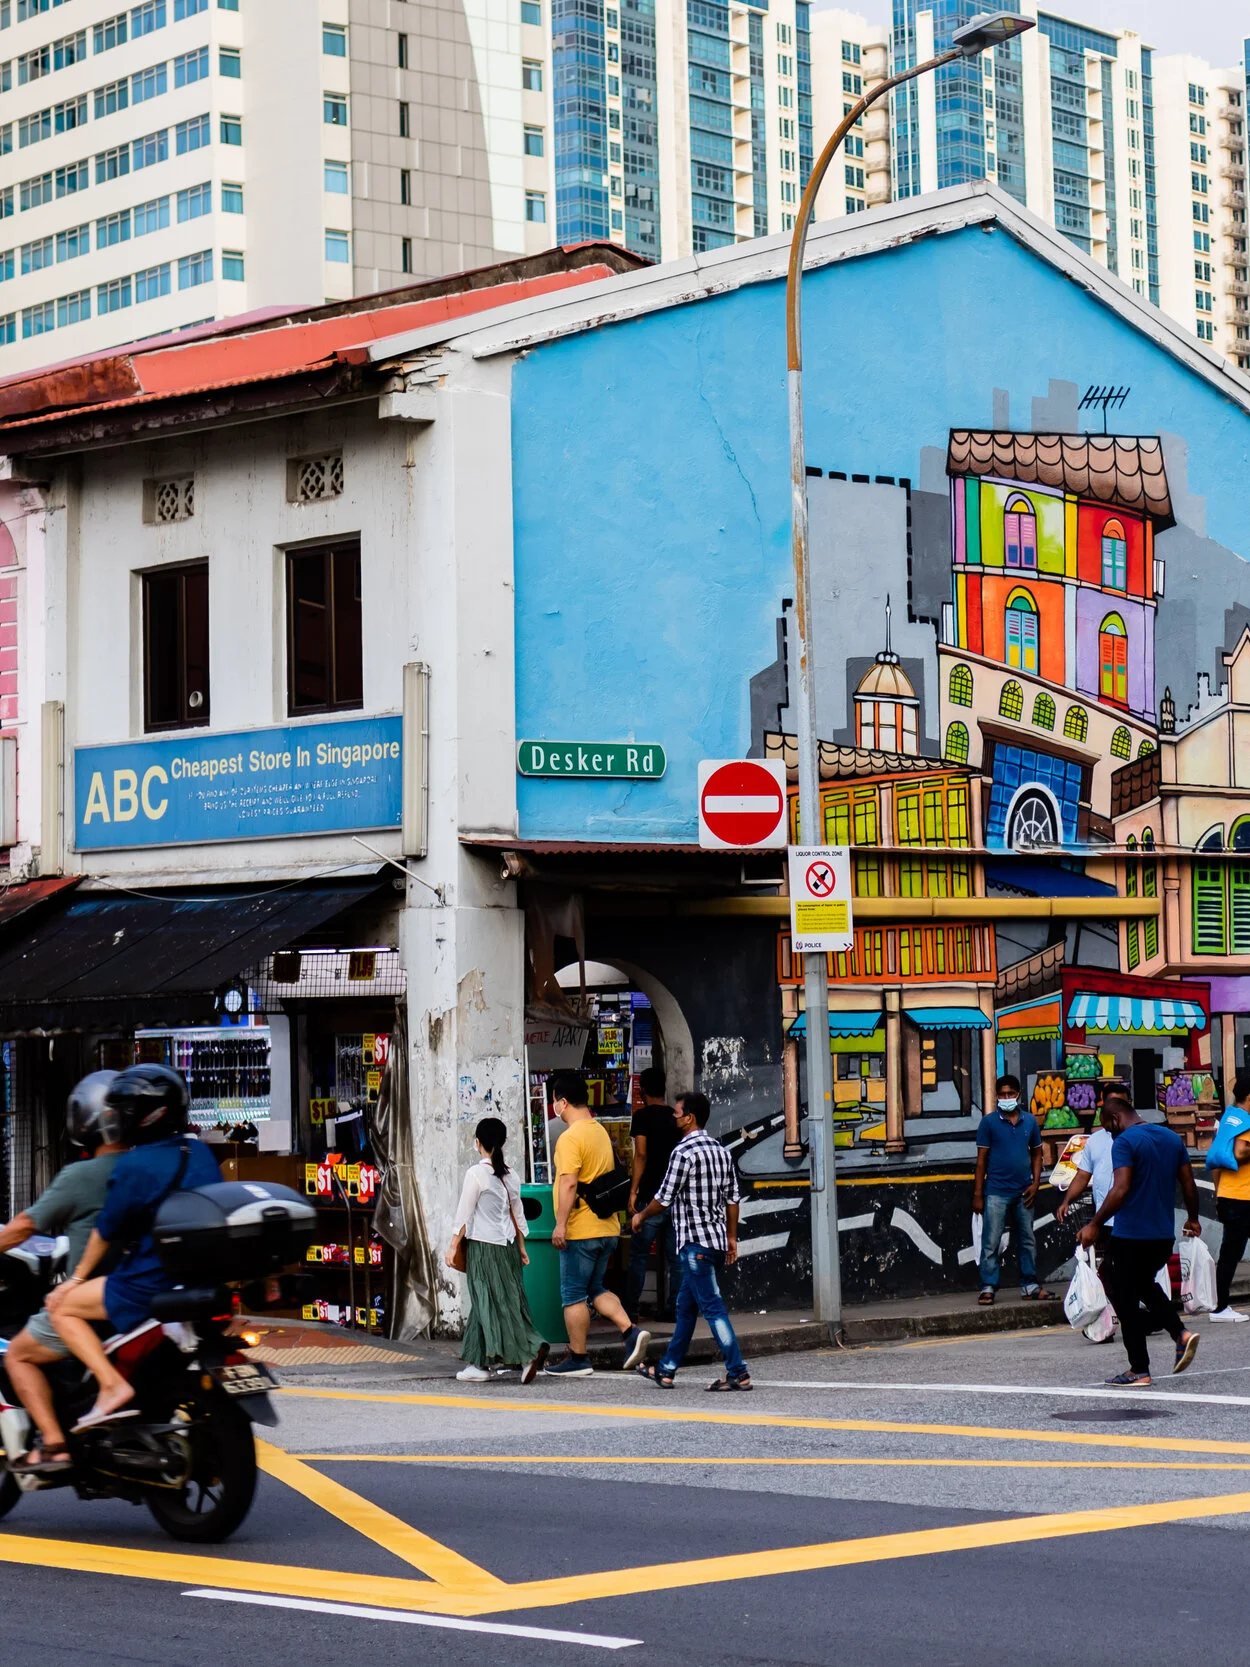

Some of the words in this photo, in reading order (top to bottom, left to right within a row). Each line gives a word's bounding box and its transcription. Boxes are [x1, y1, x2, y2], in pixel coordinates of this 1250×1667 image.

[171, 752, 244, 781] Cheapest
[249, 750, 291, 772] Store
[297, 748, 311, 768] In
[316, 741, 400, 769] Singapore
[531, 745, 614, 772] Desker
[627, 748, 654, 773] Rd
[83, 764, 169, 825] ABC
[598, 1041, 623, 1049] WATCH
[317, 1166, 332, 1192] $1
[360, 1167, 374, 1194] $1
[372, 1249, 382, 1263] $1
